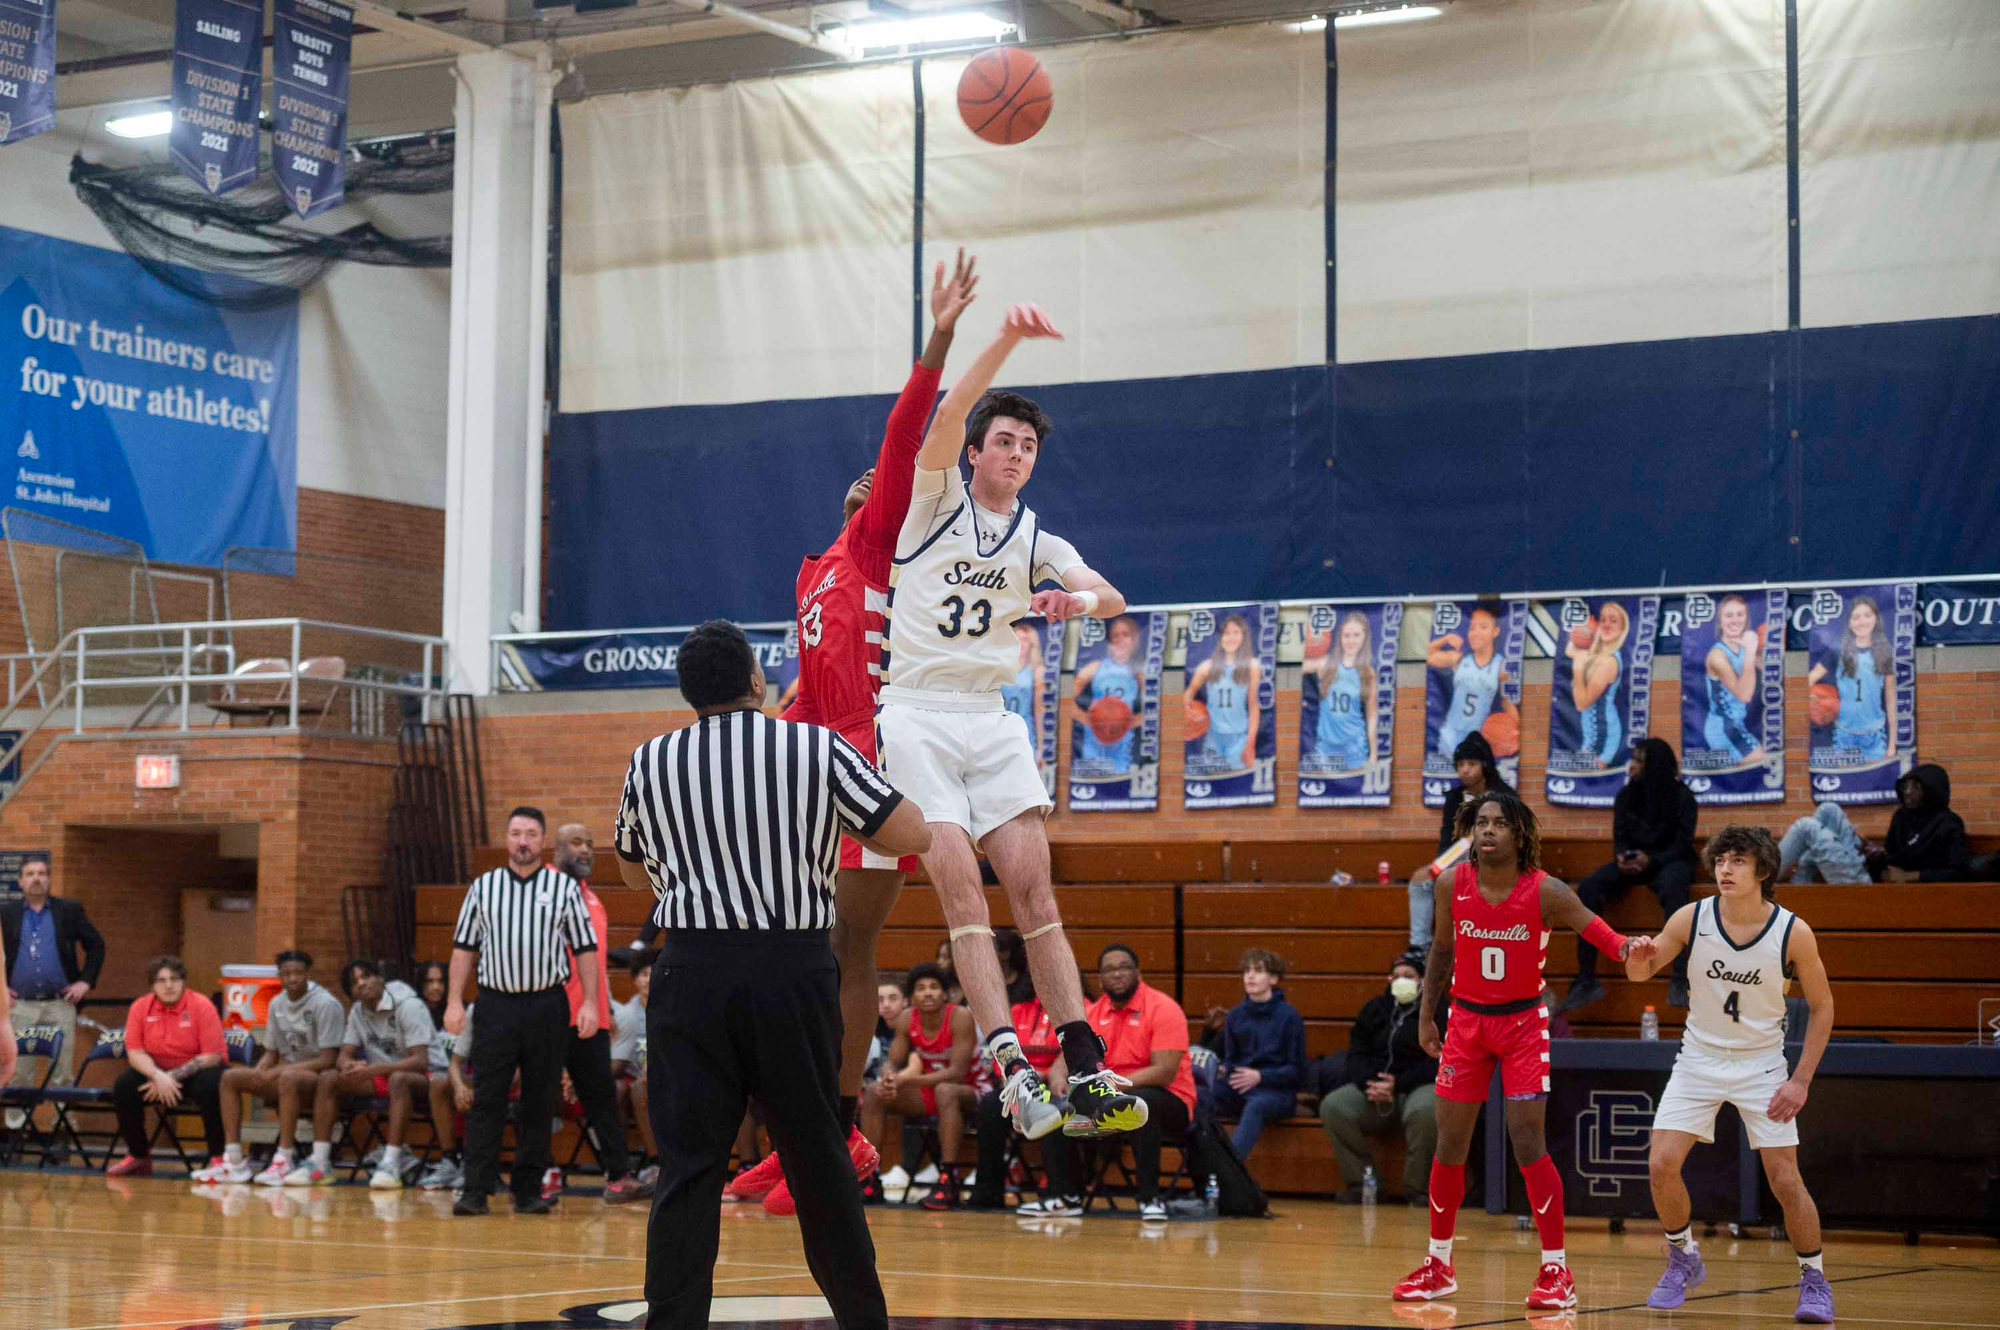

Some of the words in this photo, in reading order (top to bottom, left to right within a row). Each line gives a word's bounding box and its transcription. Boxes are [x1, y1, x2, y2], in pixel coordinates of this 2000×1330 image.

[195, 19, 241, 43] SAILING
[298, 49, 324, 68] BOYS
[186, 69, 240, 97] DIVISION
[241, 84, 250, 100] 1
[196, 92, 235, 116] STATE
[278, 95, 332, 125] DIVISION
[178, 106, 255, 139] CHAMPIONS
[291, 117, 327, 141] STATE
[200, 131, 229, 152] 2021
[292, 154, 320, 177] 2021
[22, 304, 82, 347] Our
[89, 319, 207, 372] trainers
[213, 352, 275, 384] care
[21, 356, 67, 398] for
[71, 375, 141, 411] your
[146, 384, 270, 434] athletes!
[17, 467, 75, 490] Ascension
[32, 487, 61, 506] John
[62, 491, 110, 513] Hospital
[937, 595, 993, 639] 33
[583, 644, 679, 674] GROSSE
[1761, 588, 1789, 752] DEVEROUX
[1331, 691, 1351, 713] 10
[1463, 692, 1479, 717] 5
[1459, 919, 1531, 941] Roseville
[1480, 946, 1506, 981] 0
[1706, 959, 1763, 986] South
[1723, 990, 1741, 1023] 4
